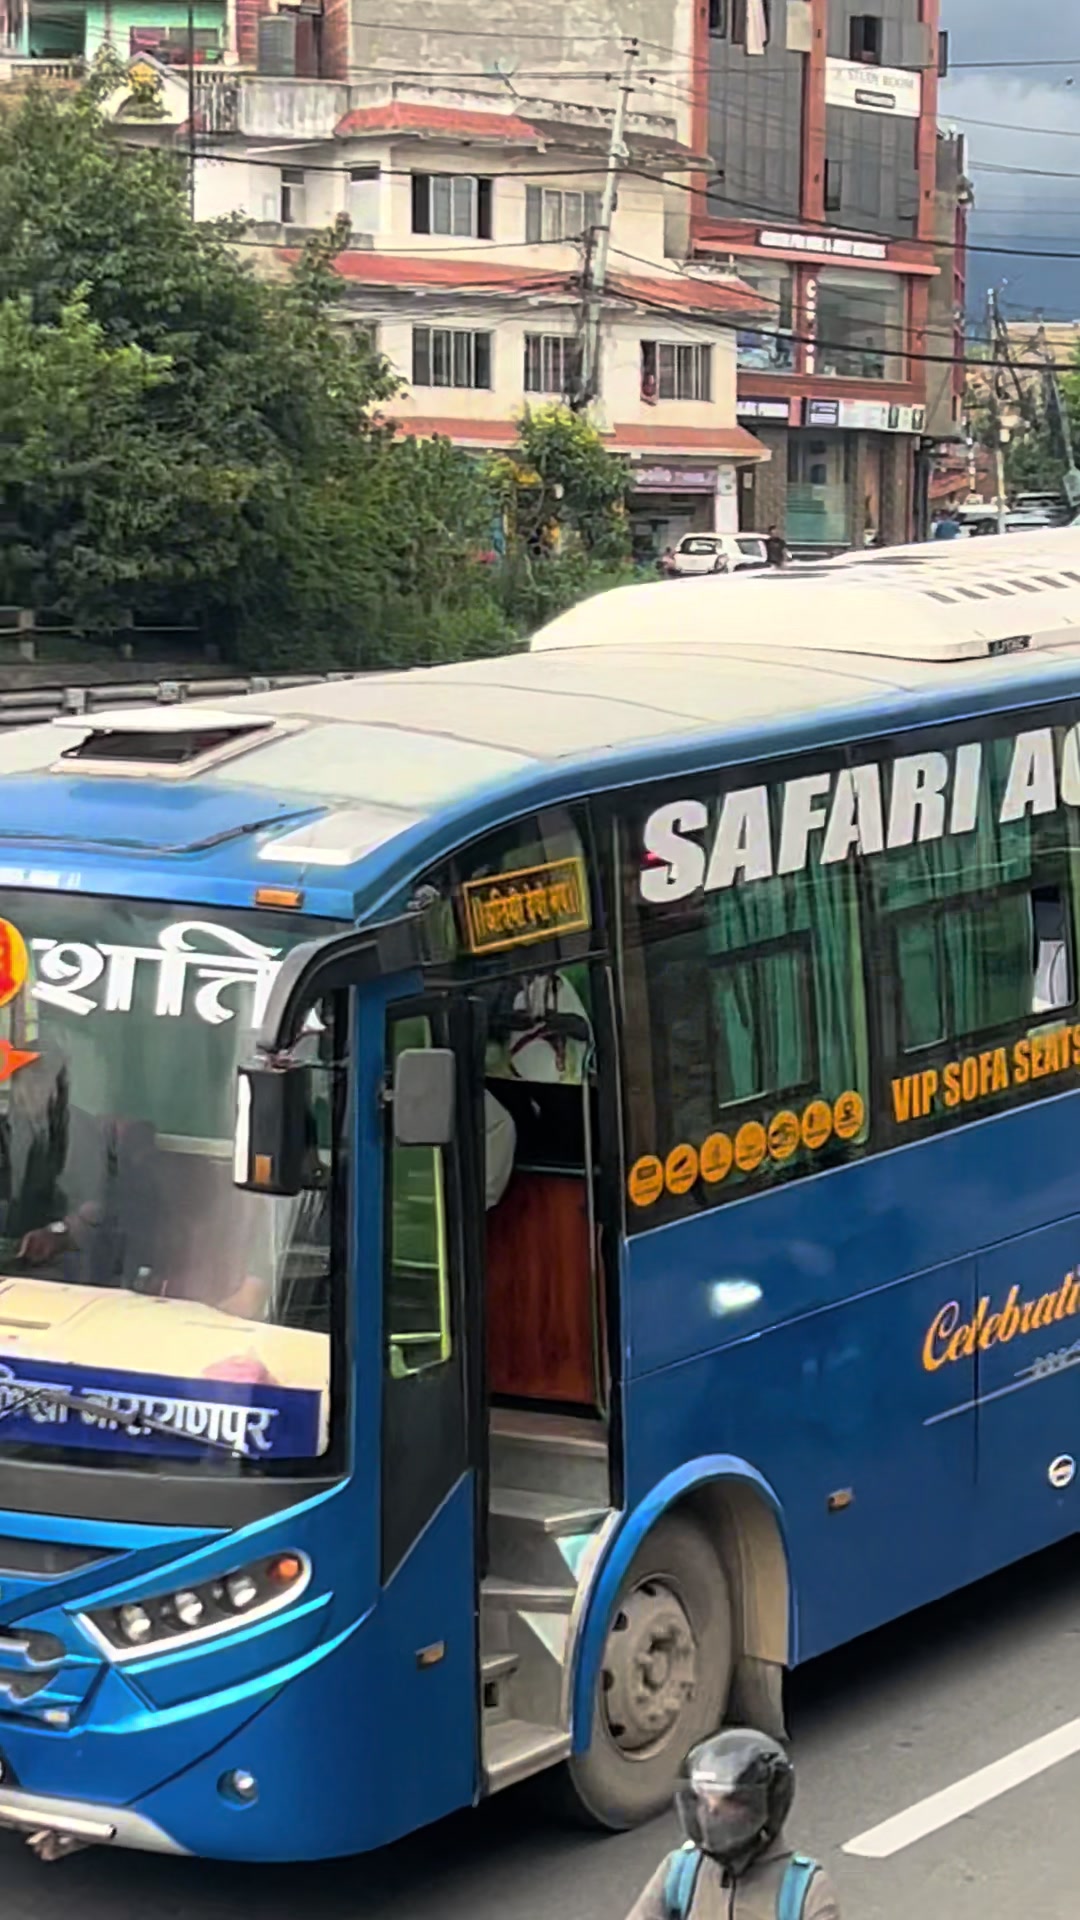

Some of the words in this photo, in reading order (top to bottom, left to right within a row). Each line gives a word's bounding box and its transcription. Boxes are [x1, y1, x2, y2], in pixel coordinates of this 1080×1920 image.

[640, 743, 983, 903] SAFARI
[892, 1069, 938, 1123] VIP
[943, 1047, 1009, 1107] SOFA
